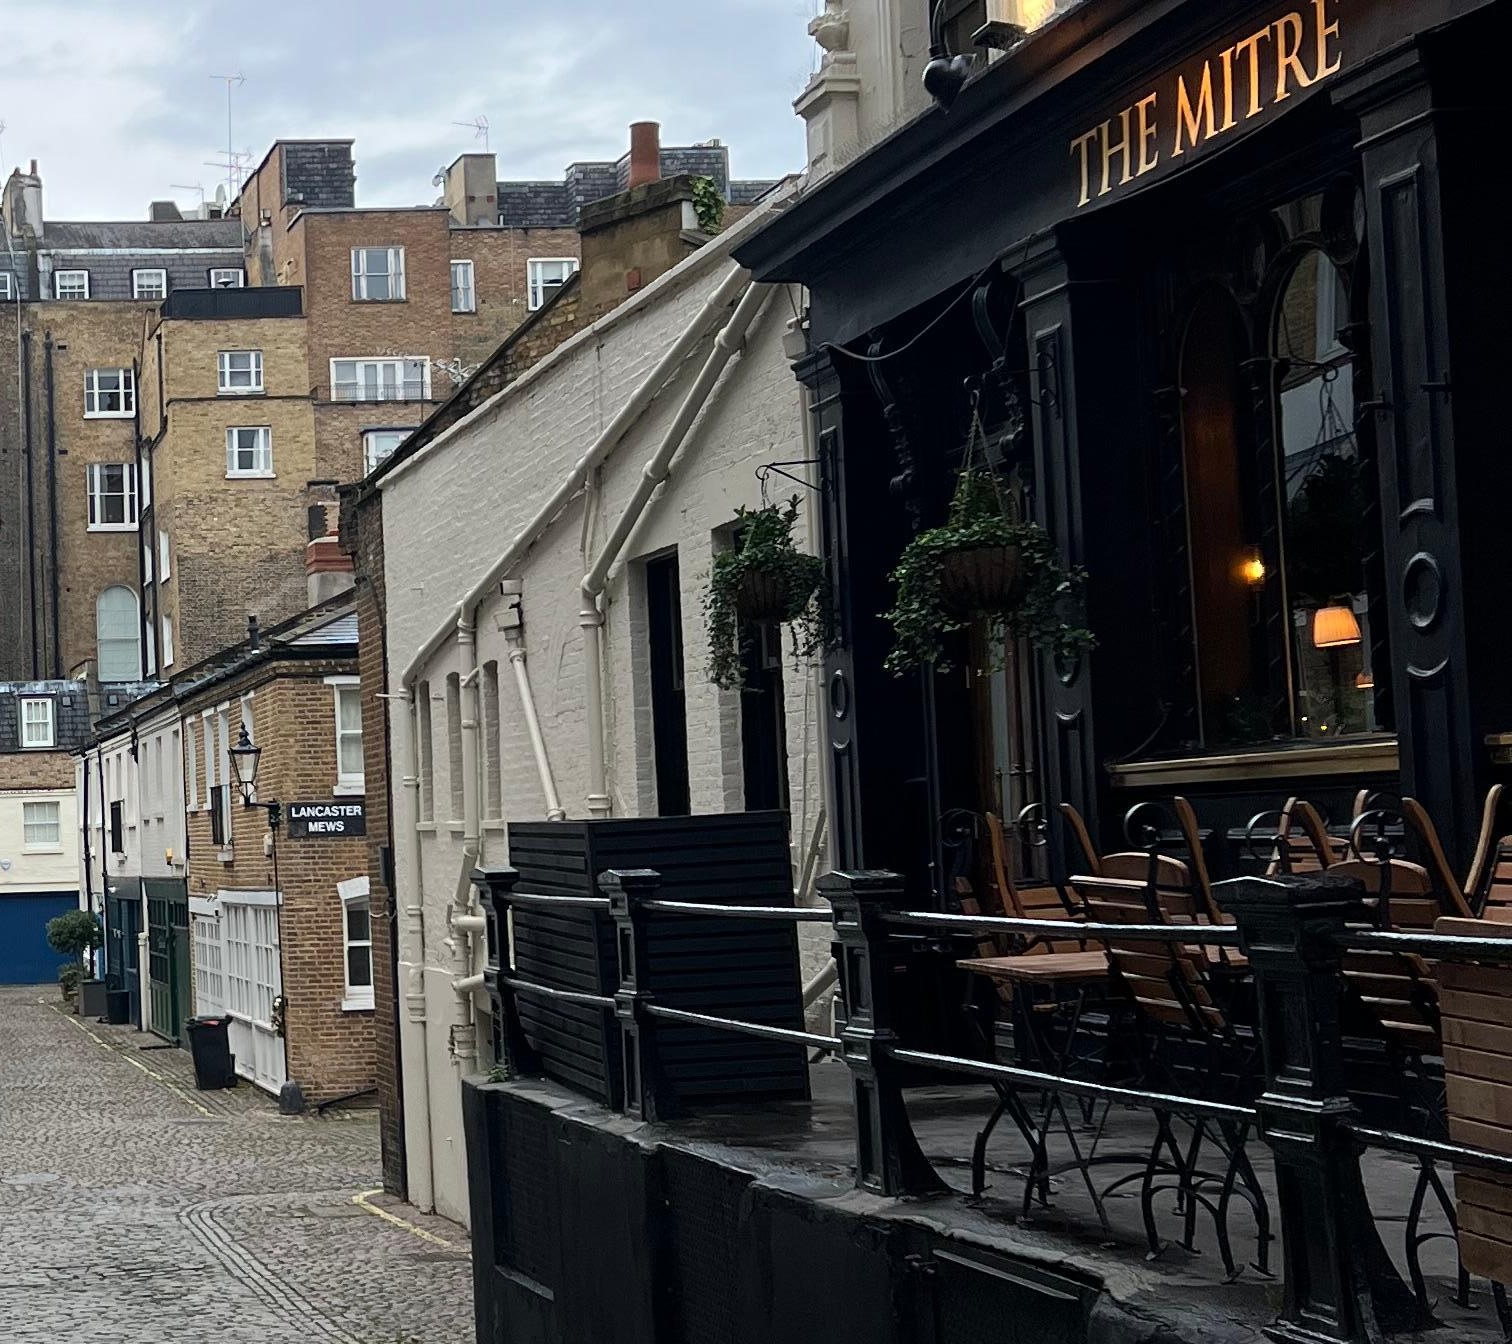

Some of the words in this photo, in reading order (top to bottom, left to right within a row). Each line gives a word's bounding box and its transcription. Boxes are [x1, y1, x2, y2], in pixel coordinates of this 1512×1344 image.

[1070, 92, 1158, 207] THE
[291, 805, 362, 818] LANCASTER
[308, 820, 345, 832] MEWS
